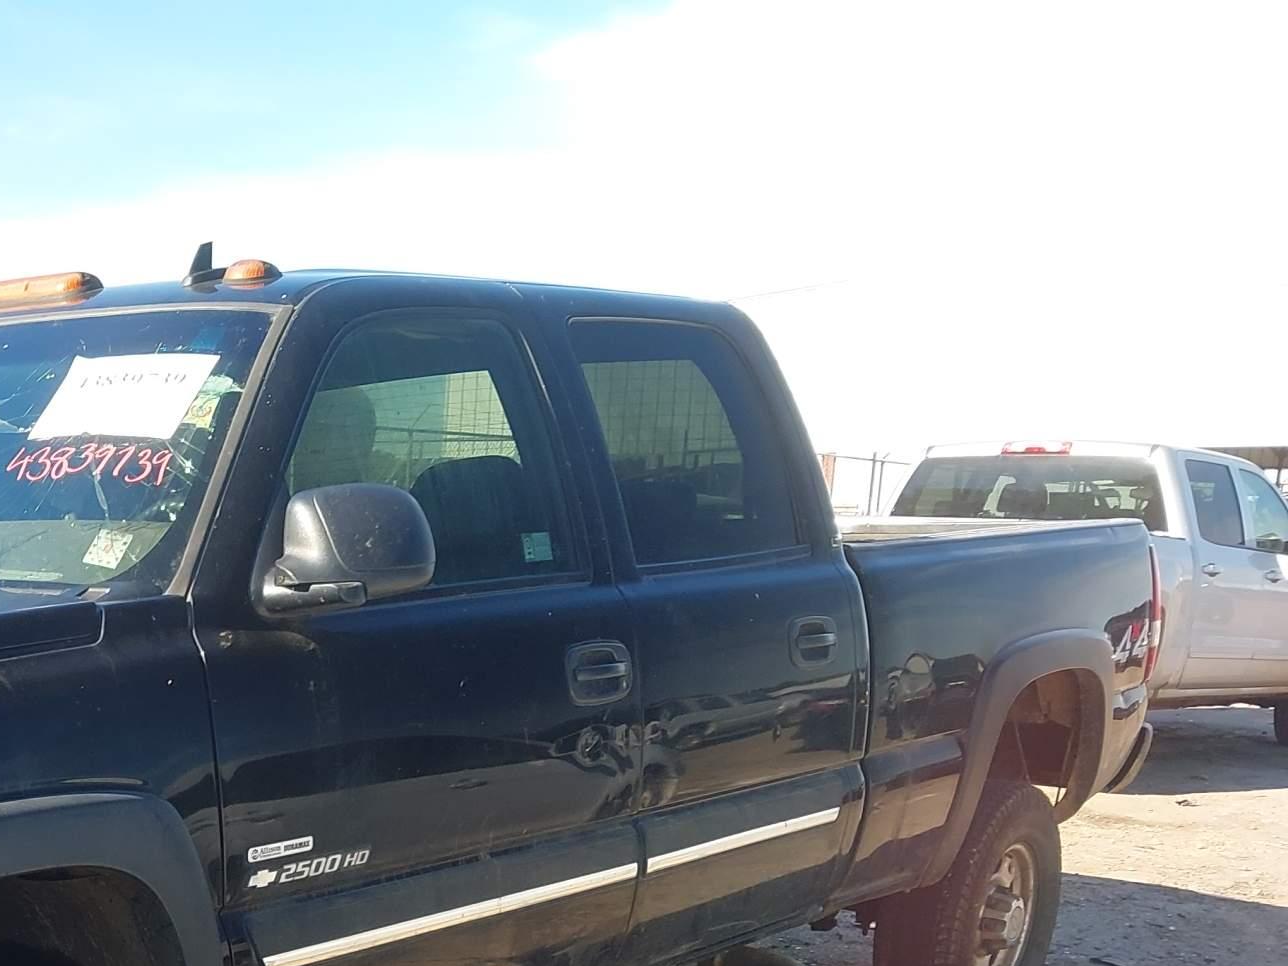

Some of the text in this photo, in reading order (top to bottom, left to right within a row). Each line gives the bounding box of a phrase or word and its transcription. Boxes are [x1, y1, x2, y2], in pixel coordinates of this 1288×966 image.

[6, 442, 173, 487] 43839739
[279, 849, 370, 884] 2500 HD
